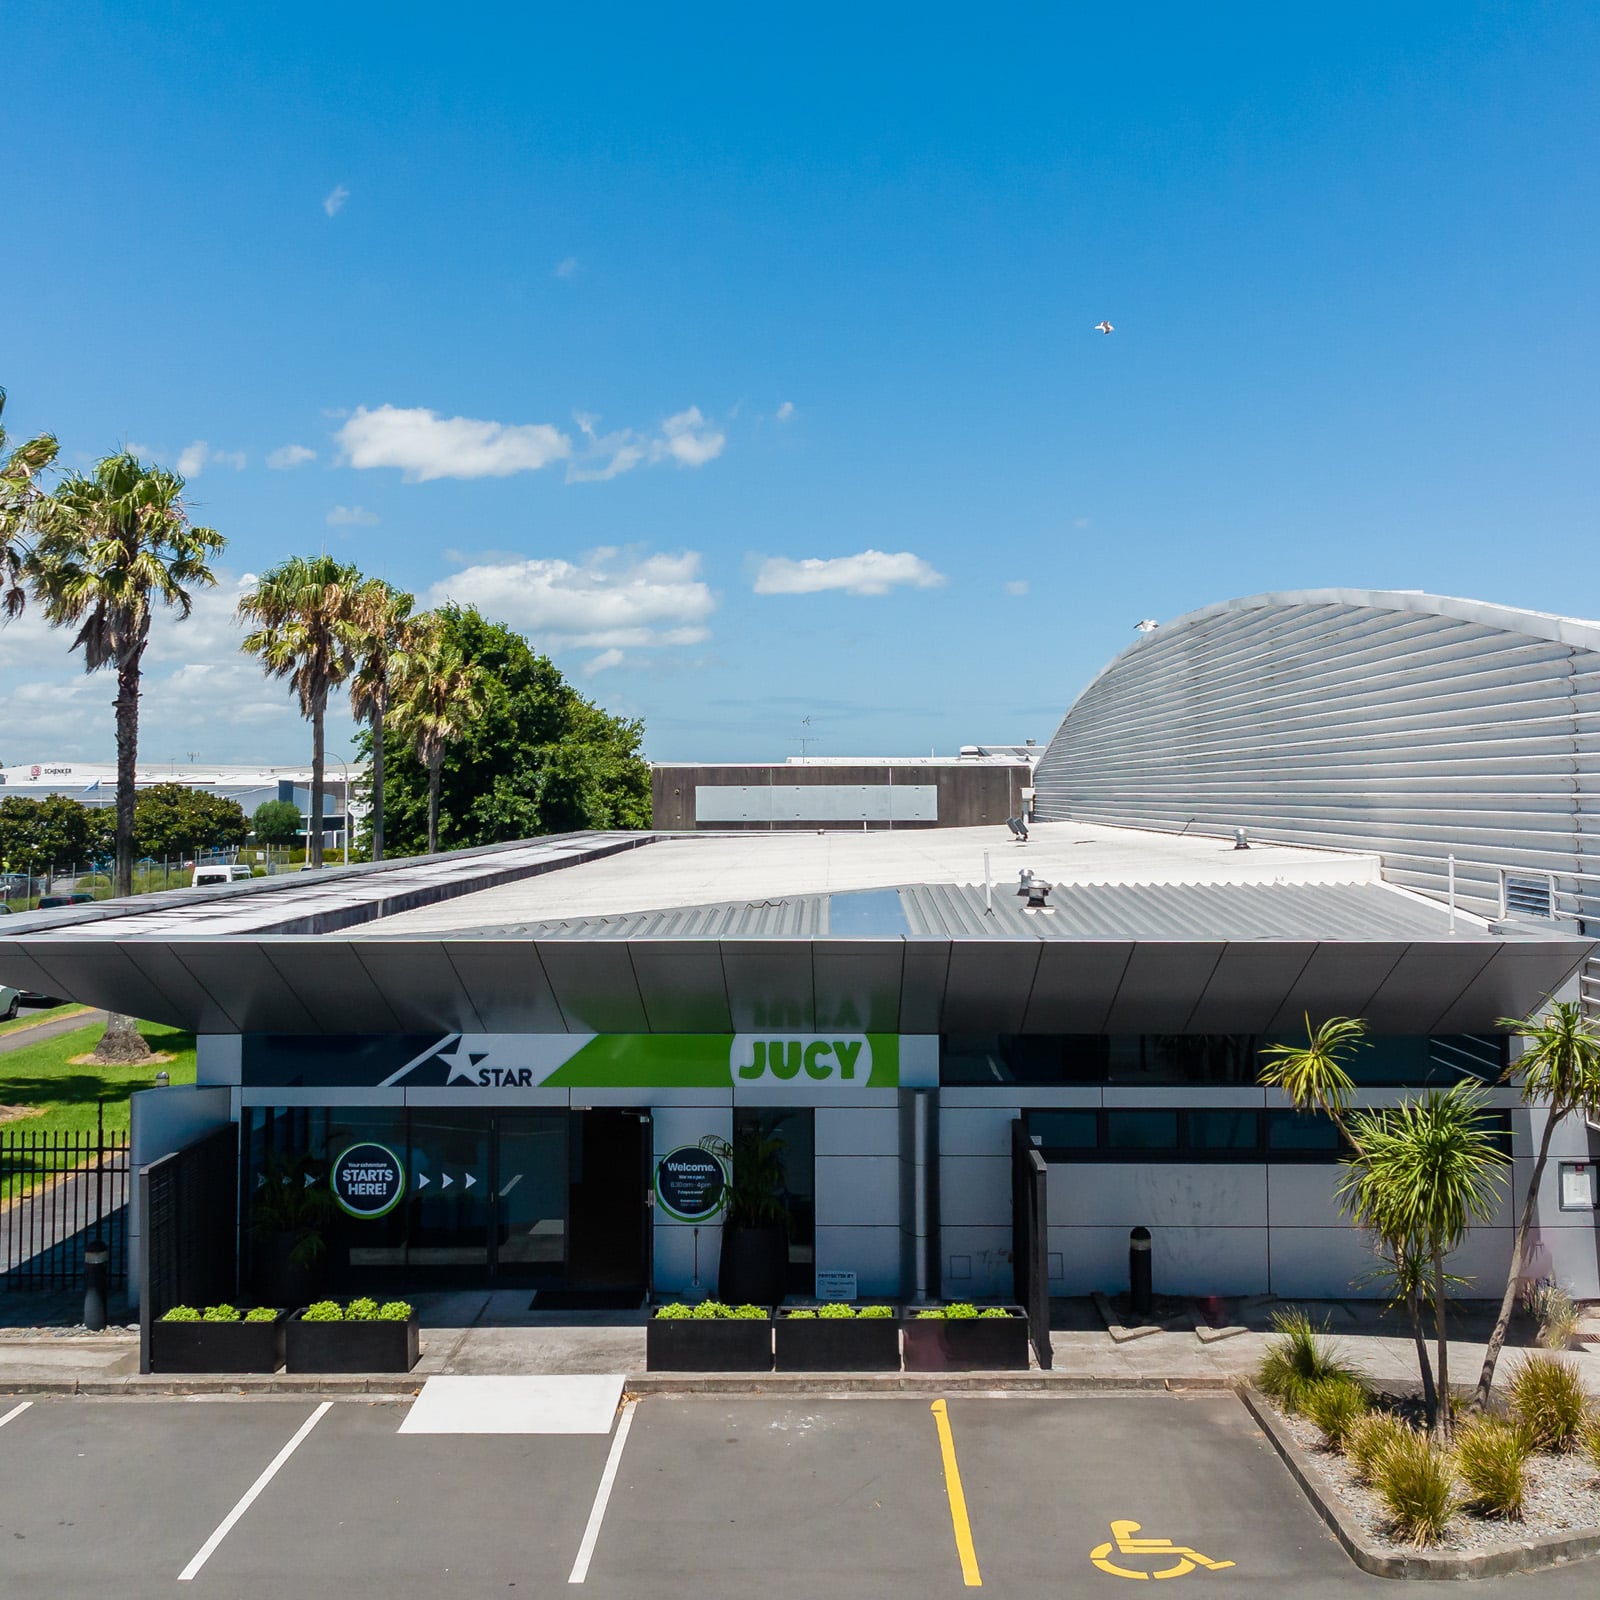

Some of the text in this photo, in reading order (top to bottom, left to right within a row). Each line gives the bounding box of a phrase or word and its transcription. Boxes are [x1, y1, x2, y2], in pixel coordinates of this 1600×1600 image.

[739, 1041, 862, 1080] JUCY
[478, 1068, 532, 1087] STAR
[667, 1162, 716, 1172] Welcome.
[342, 1169, 393, 1182] STARTS
[348, 1183, 387, 1195] HERE!
